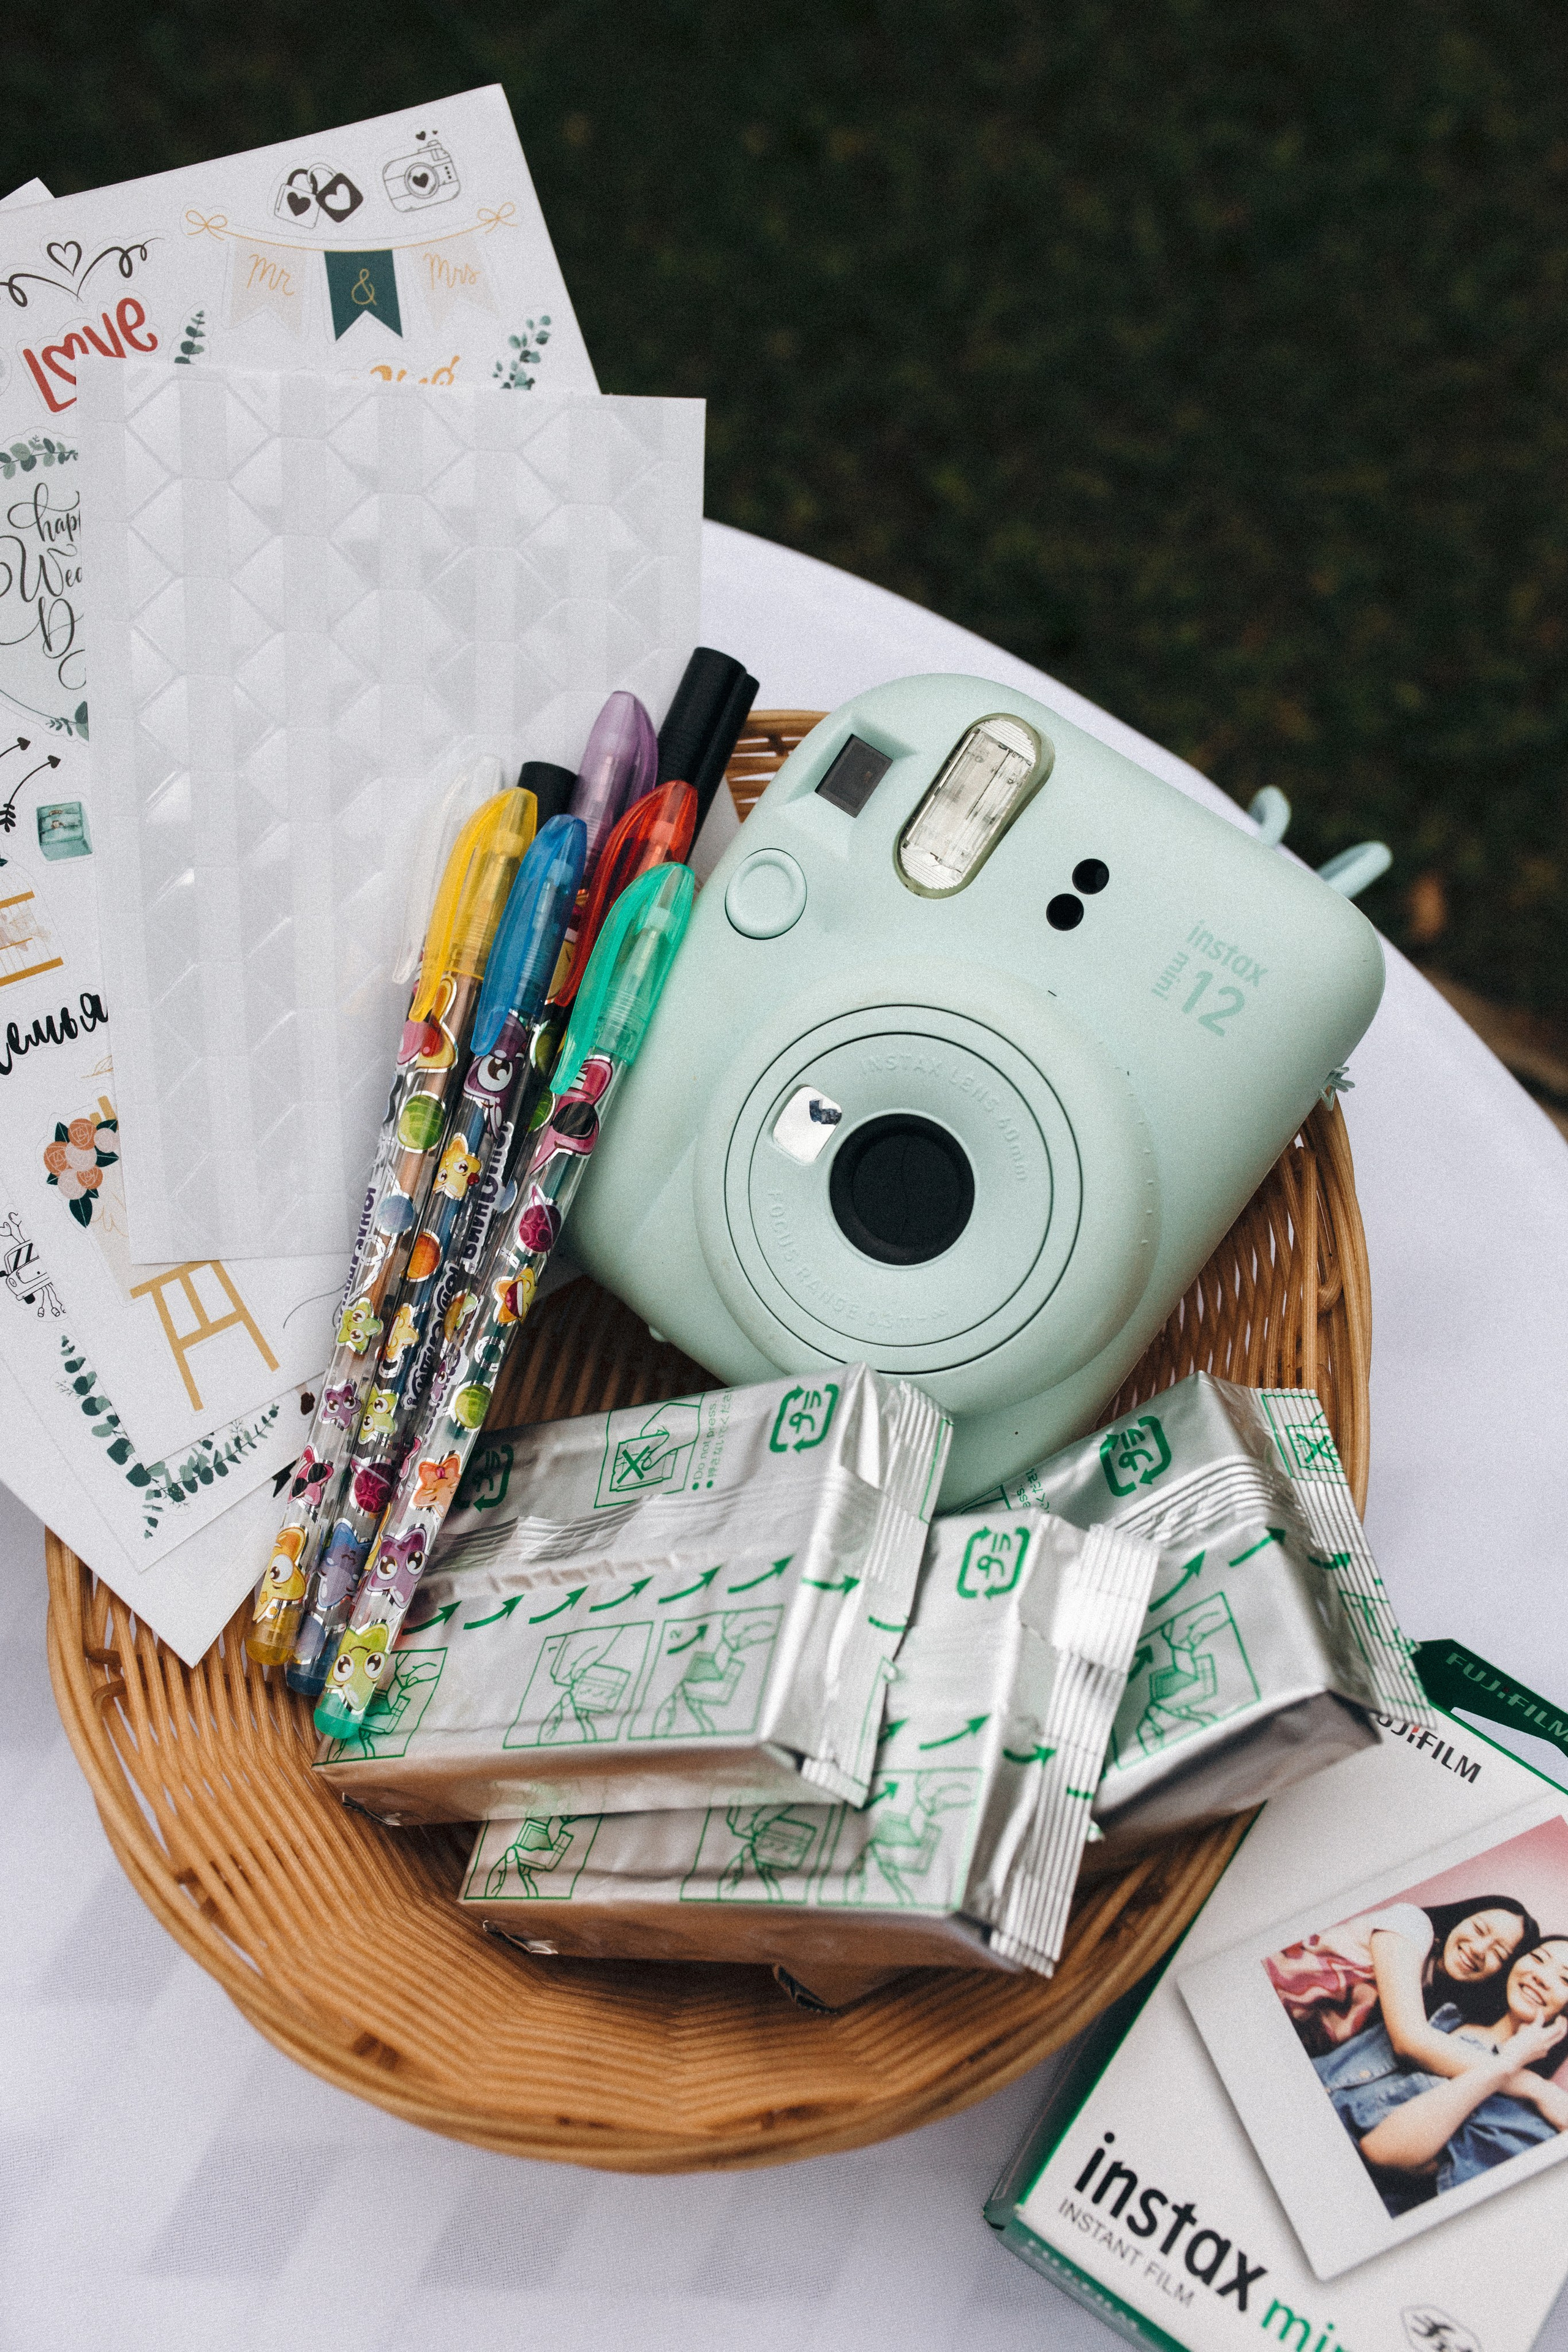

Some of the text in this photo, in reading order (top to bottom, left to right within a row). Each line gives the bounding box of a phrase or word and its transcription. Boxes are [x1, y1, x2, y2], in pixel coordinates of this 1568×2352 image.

[247, 252, 481, 306] Mr & Mrs
[7, 482, 82, 543] hap
[1151, 951, 1189, 1001] mini
[1185, 919, 1268, 988] instax
[1181, 969, 1245, 1038] 12
[766, 1189, 801, 1264] FOCUS
[693, 1460, 706, 1480] Do
[700, 1440, 712, 1460] not
[1445, 1652, 1568, 1743] FUJIFILM
[1058, 2198, 1143, 2264] INSTANT
[1144, 2260, 1196, 2309] FILM
[1072, 2130, 1268, 2312] instax
[1261, 2297, 1352, 2352] mi
